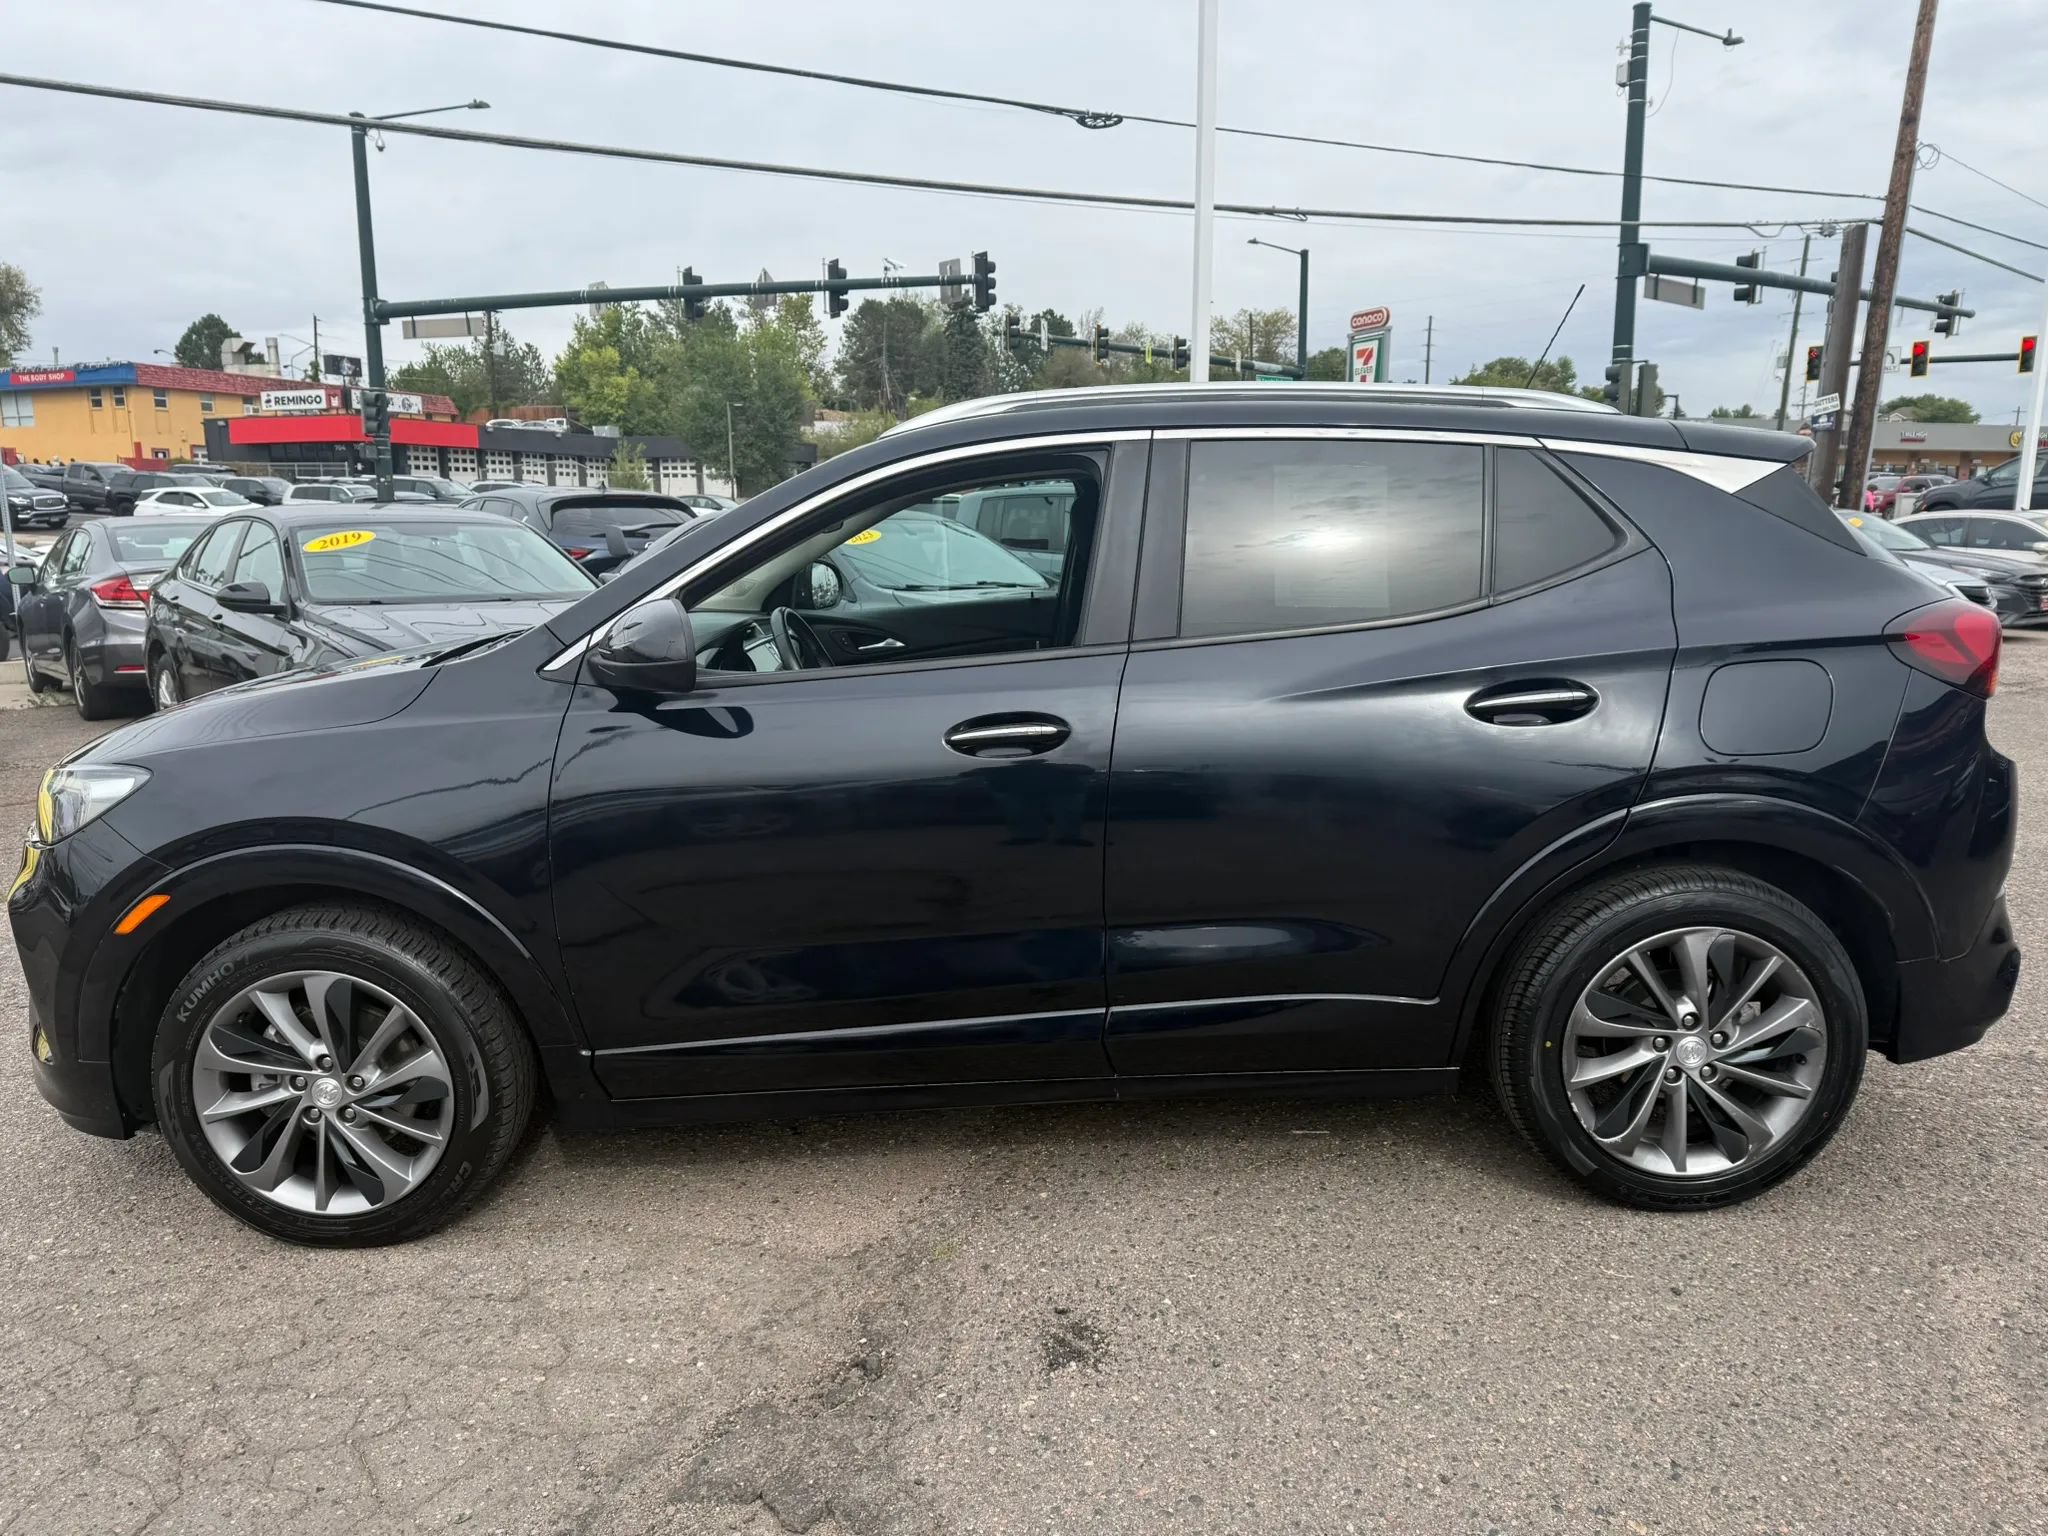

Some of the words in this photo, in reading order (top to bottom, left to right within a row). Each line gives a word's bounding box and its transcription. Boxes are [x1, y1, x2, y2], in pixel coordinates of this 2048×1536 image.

[1356, 346, 1374, 366] 7
[18, 374, 30, 382] THE
[31, 373, 47, 381] BODY
[48, 372, 65, 380] SHOP
[274, 394, 322, 407] REMINGO
[319, 532, 362, 550] 2019
[176, 962, 235, 1023] KUMHO
